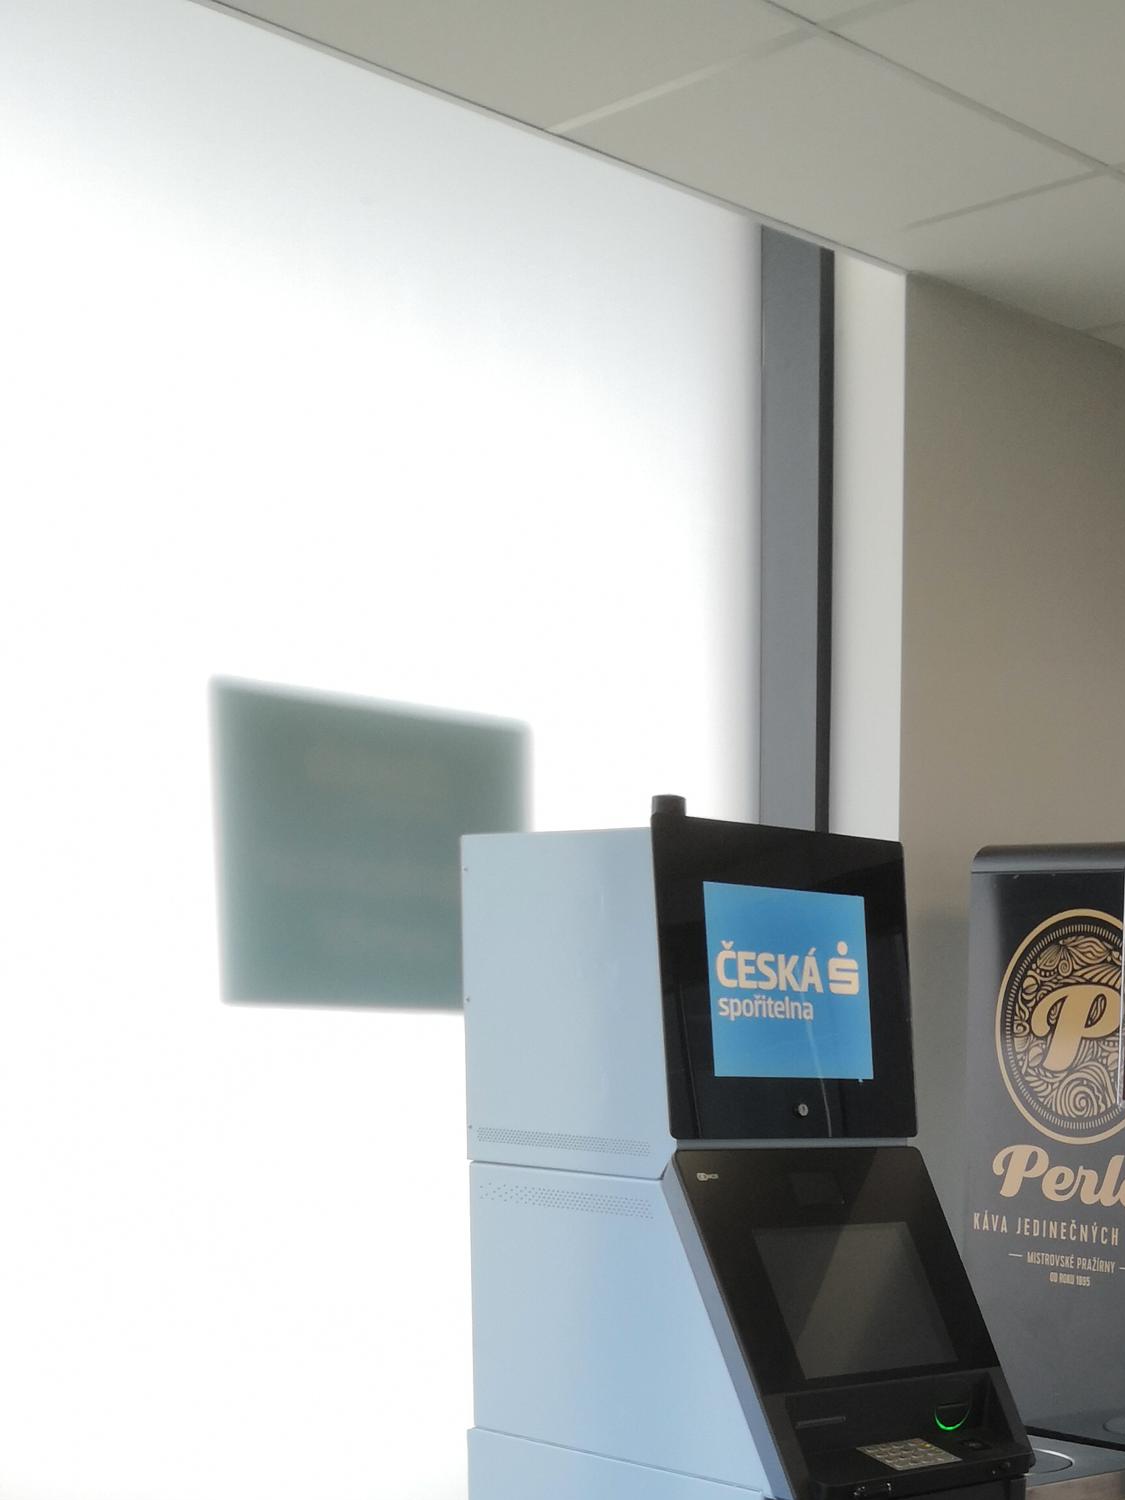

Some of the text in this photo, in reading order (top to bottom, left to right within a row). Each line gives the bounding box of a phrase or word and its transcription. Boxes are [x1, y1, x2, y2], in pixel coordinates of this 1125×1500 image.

[716, 940, 824, 993] ČESKÁ
[718, 994, 814, 1021] spořitelna
[973, 1210, 1008, 1233] KÁVA
[1016, 1217, 1119, 1246] JEDINEČNÝCH
[1027, 1251, 1116, 1274] MISTROVSKÉ PRAŽÍRNY
